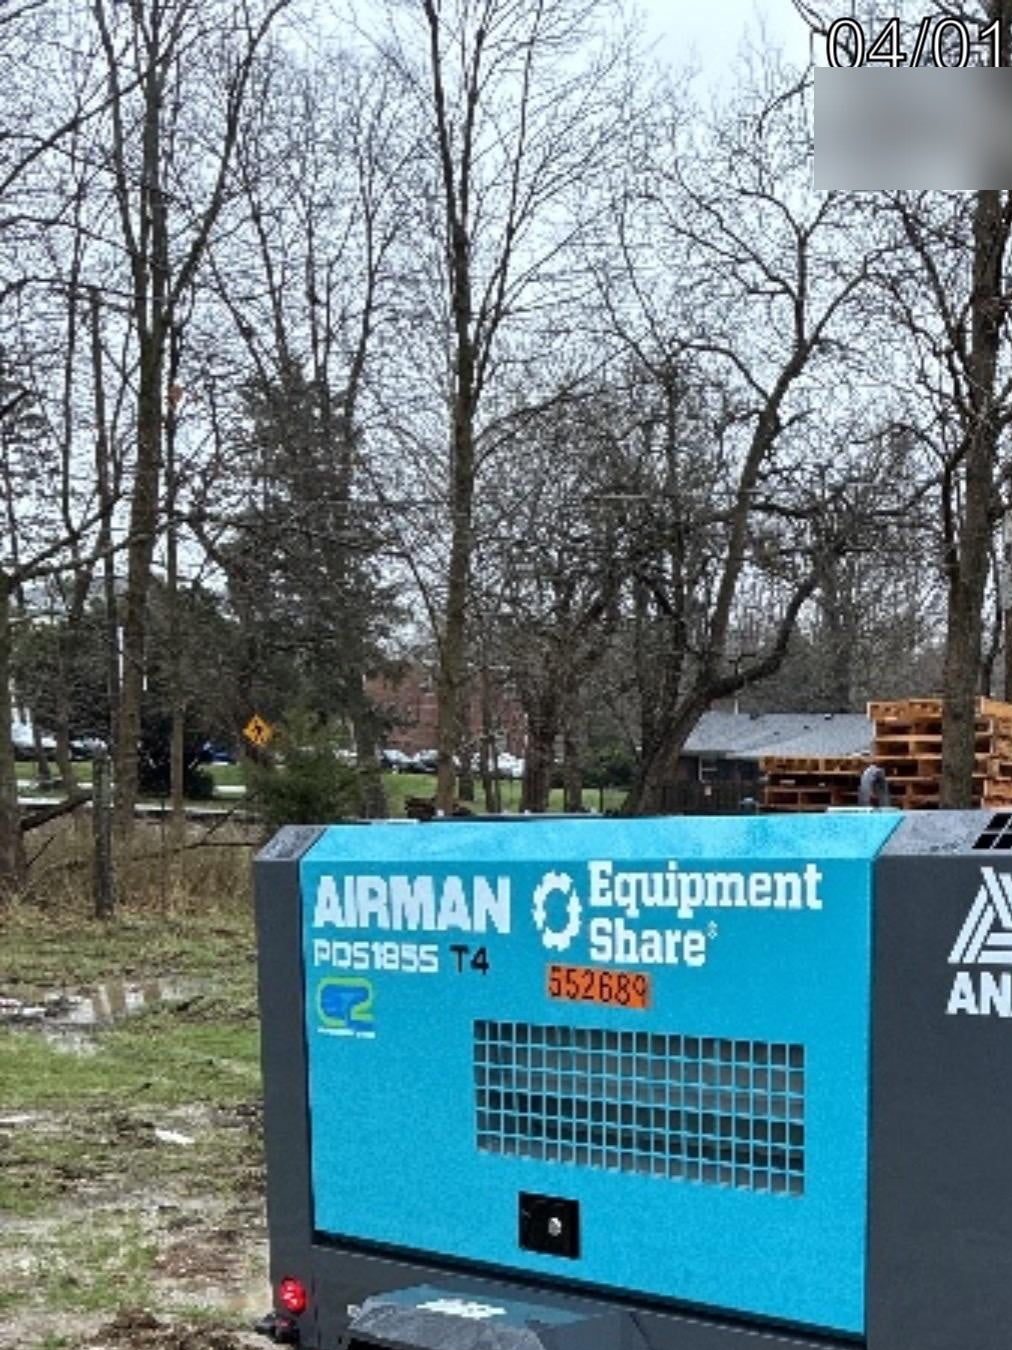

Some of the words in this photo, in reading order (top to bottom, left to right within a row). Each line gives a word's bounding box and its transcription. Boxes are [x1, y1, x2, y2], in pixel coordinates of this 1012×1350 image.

[312, 875, 511, 934] AIRMAN
[588, 859, 823, 919] Equipment
[313, 939, 439, 973] PDS185S
[450, 944, 489, 976] T4
[549, 965, 648, 1007] 552689
